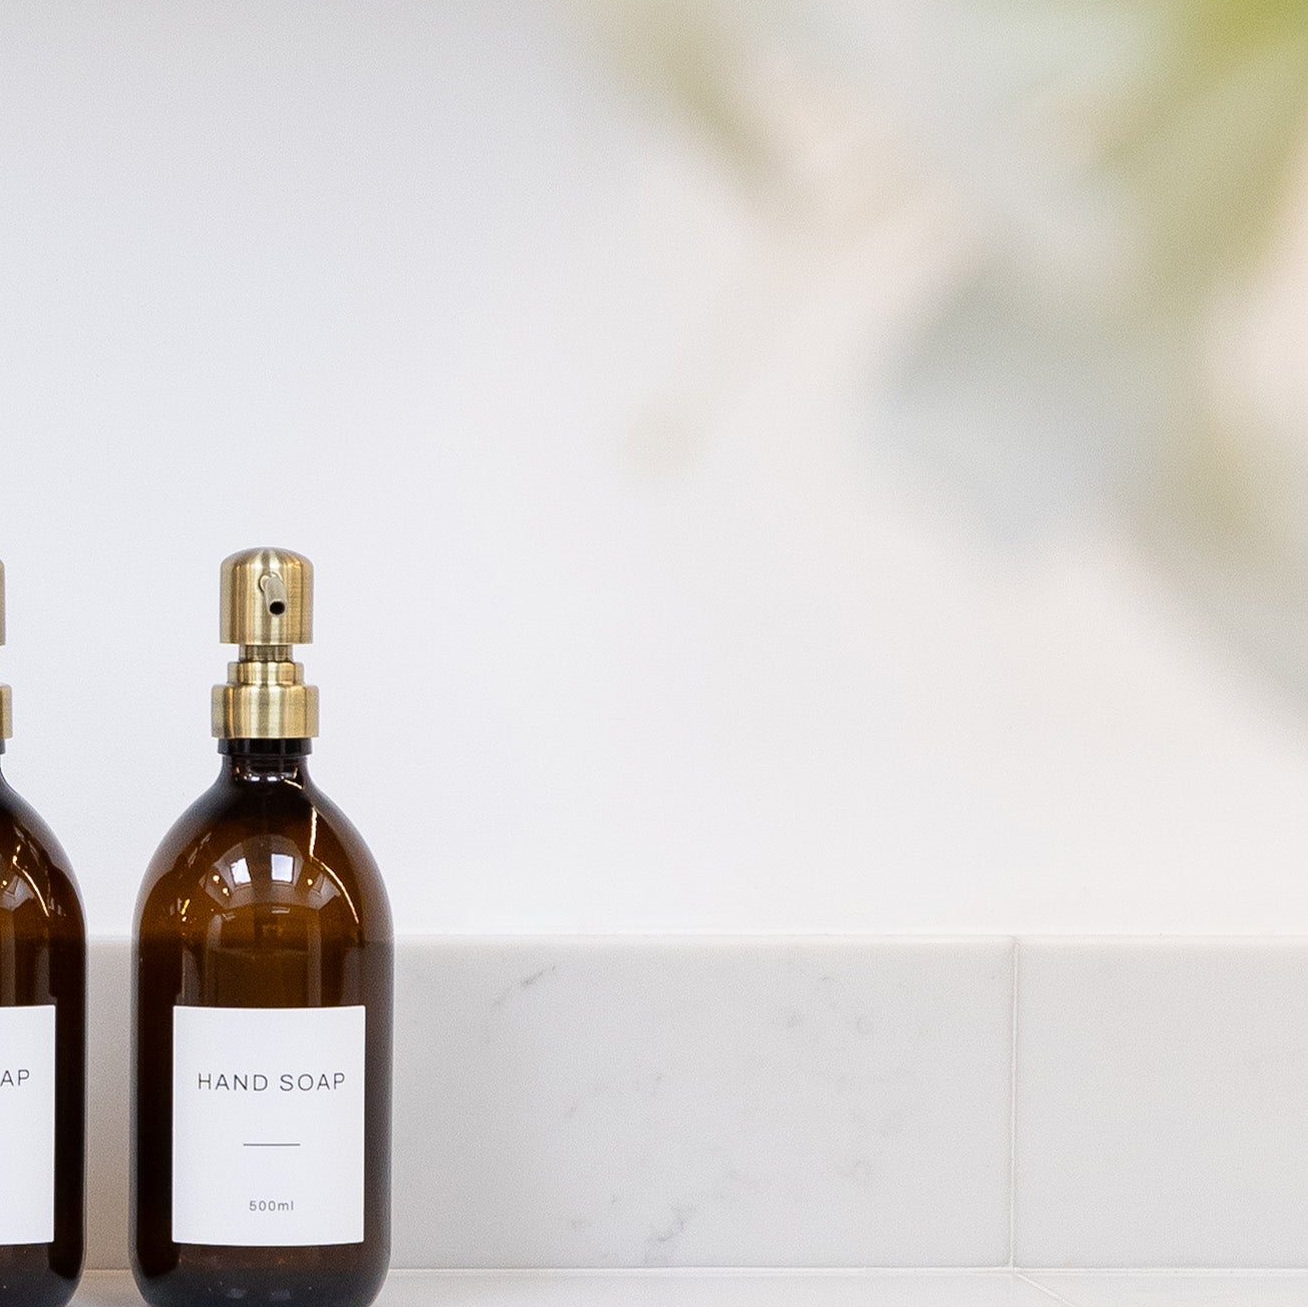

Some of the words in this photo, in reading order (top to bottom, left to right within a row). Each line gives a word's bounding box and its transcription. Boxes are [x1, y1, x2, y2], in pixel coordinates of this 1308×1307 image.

[197, 1072, 269, 1092] HAND
[279, 1071, 346, 1092] SOAP
[248, 1199, 295, 1212] 500ml
